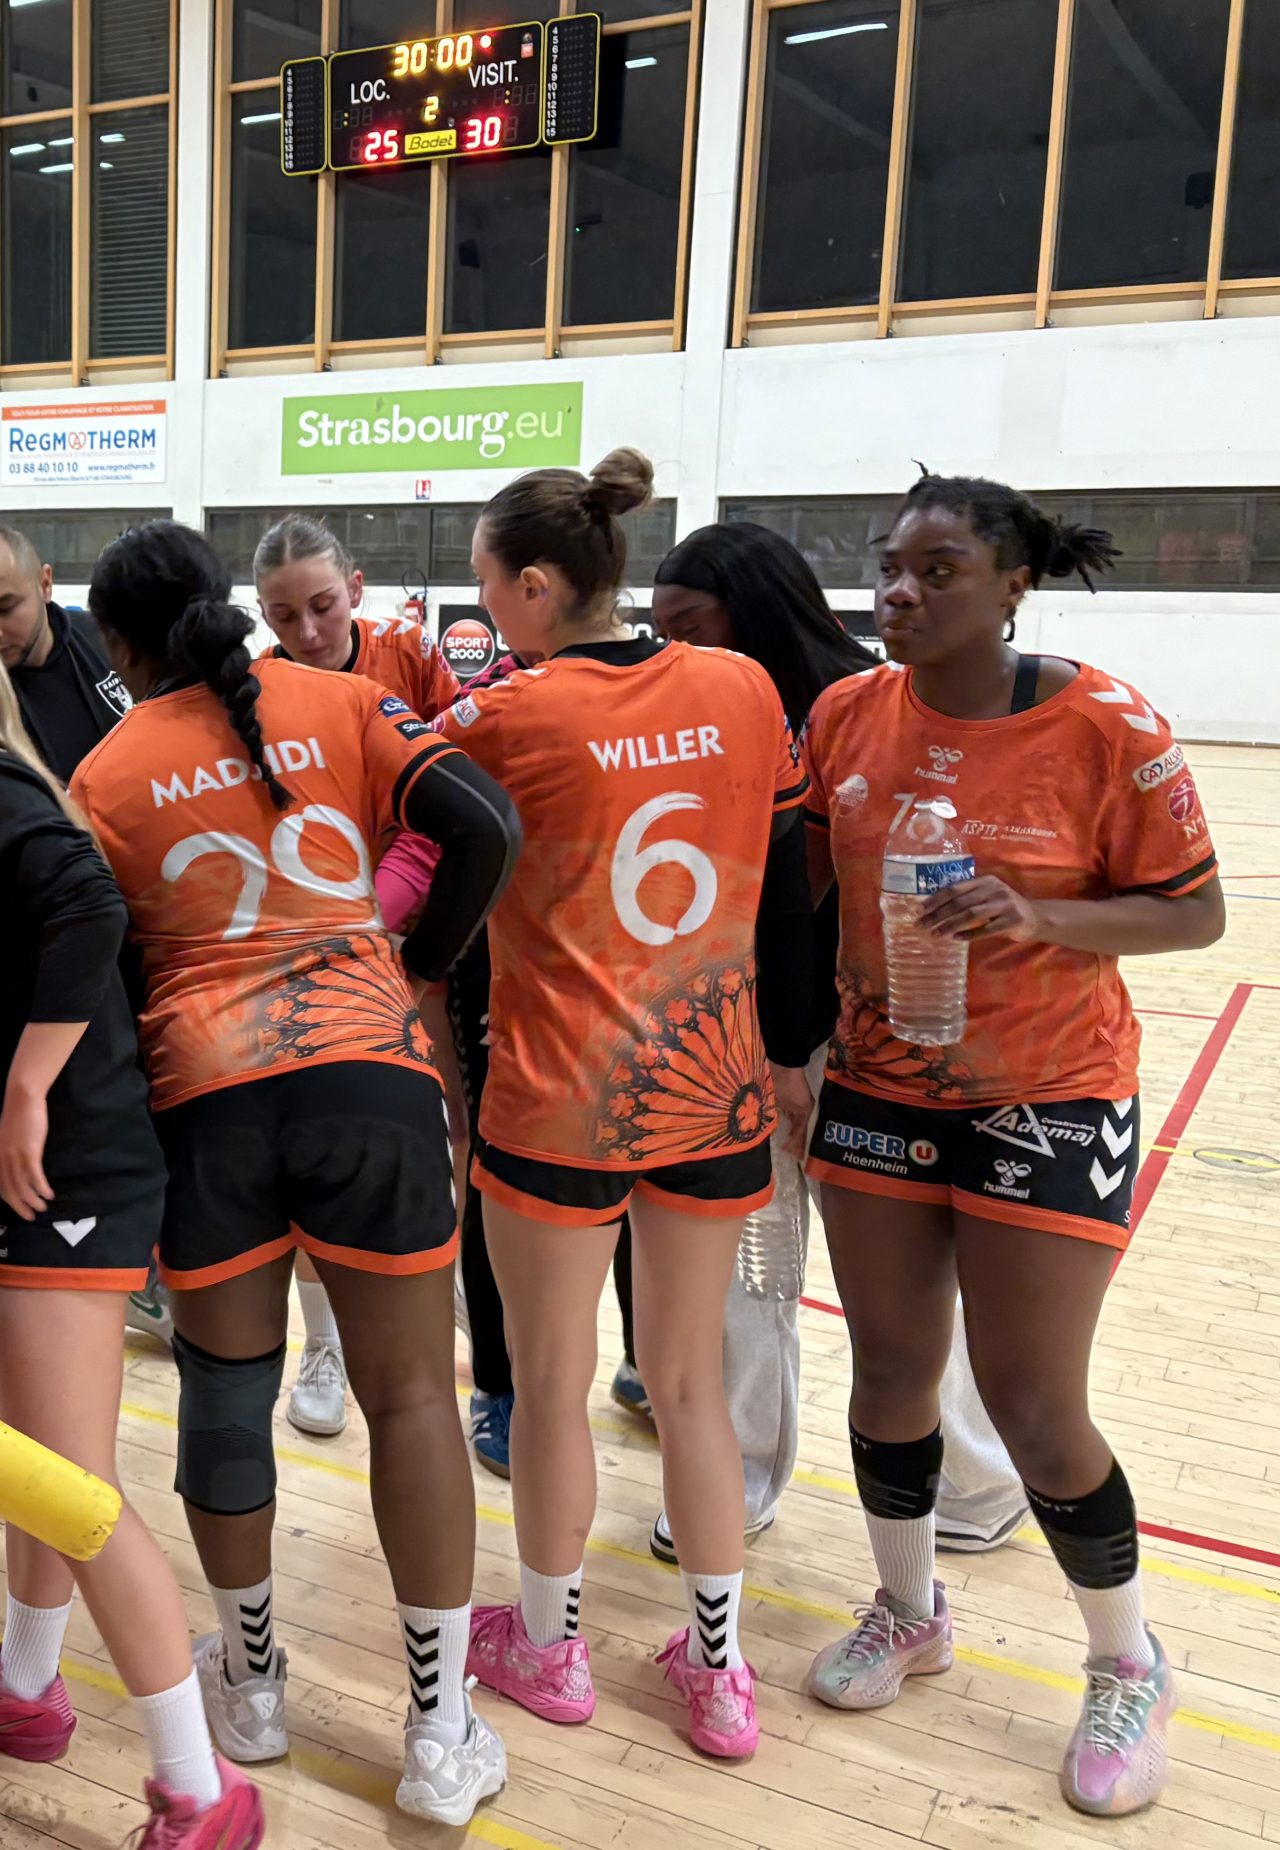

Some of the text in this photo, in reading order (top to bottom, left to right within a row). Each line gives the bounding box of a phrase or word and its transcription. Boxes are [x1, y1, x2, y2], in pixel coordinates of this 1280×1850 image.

[552, 26, 558, 34] 4
[552, 36, 559, 44] 5
[393, 35, 473, 76] 30:00
[552, 45, 559, 53] 6
[467, 59, 519, 88] VISIT.
[350, 79, 391, 104] LOC.
[547, 82, 558, 91] 10
[547, 91, 556, 100] 11
[424, 96, 439, 120] 2
[547, 100, 557, 109] 12
[547, 110, 557, 118] 13
[547, 119, 556, 128] 14
[466, 117, 501, 148] 30
[546, 128, 556, 136] 15
[365, 130, 398, 160] 25
[297, 404, 563, 458] Strasbourg.eu
[9, 463, 20, 474] 03
[23, 463, 35, 474] 88
[37, 462, 50, 473] 40
[52, 462, 64, 473] 10
[67, 462, 78, 472] 10
[446, 637, 489, 648] SPORT
[449, 648, 485, 660] 2000
[586, 724, 725, 773] WILLER
[610, 790, 718, 946] 6
[823, 1120, 905, 1160] SUPER
[842, 1151, 908, 1175] Hoenheim
[983, 1180, 1030, 1200] hummel
